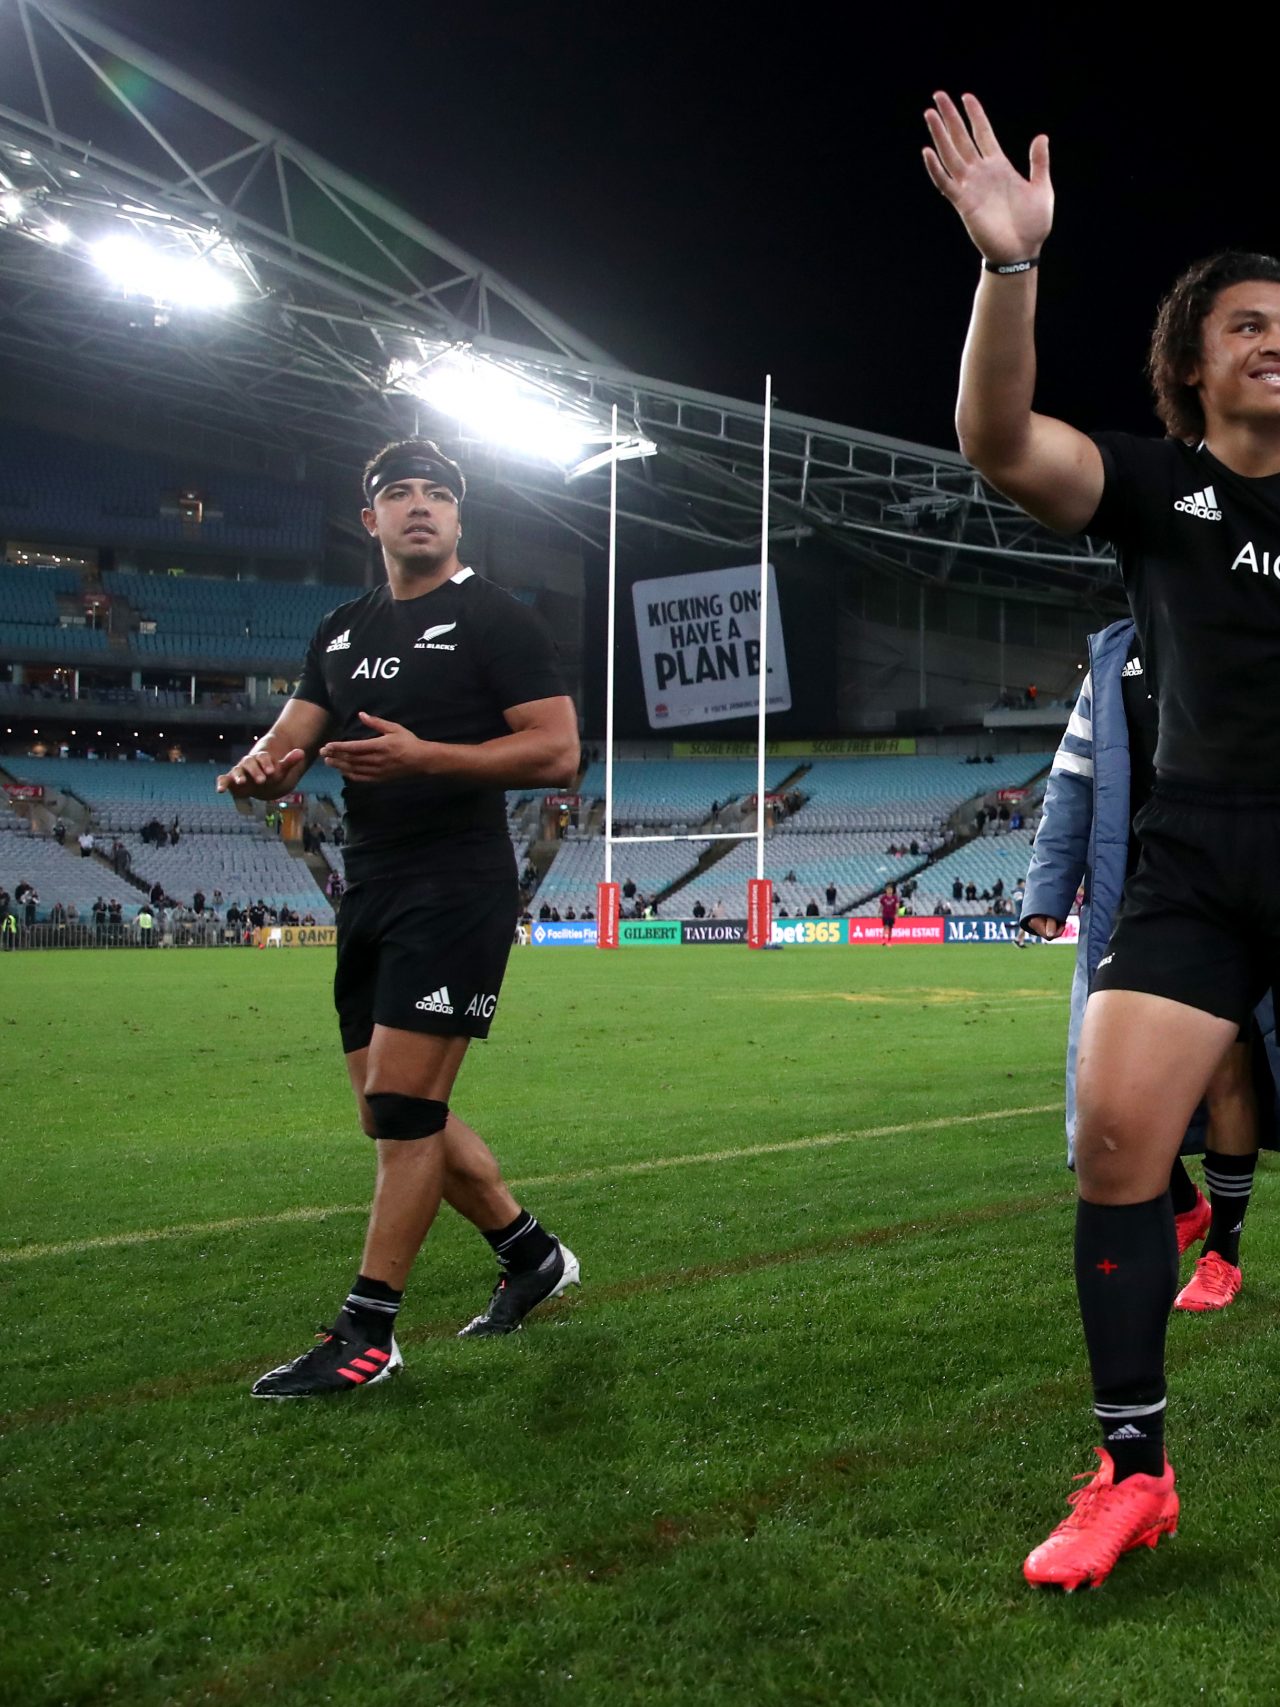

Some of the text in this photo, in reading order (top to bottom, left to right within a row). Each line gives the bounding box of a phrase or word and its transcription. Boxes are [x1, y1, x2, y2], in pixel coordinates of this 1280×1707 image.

[1174, 499, 1223, 521] adidas
[648, 594, 723, 627] KICKING
[670, 617, 741, 649] HAVE A
[426, 643, 456, 651] BLACKS
[351, 657, 401, 680] AIG
[654, 642, 740, 690] PLAN
[624, 927, 678, 940] GILBERT
[771, 922, 841, 943] bet365
[912, 927, 940, 938] ESTATE
[415, 1000, 454, 1015] adidas
[464, 993, 497, 1018] AIG
